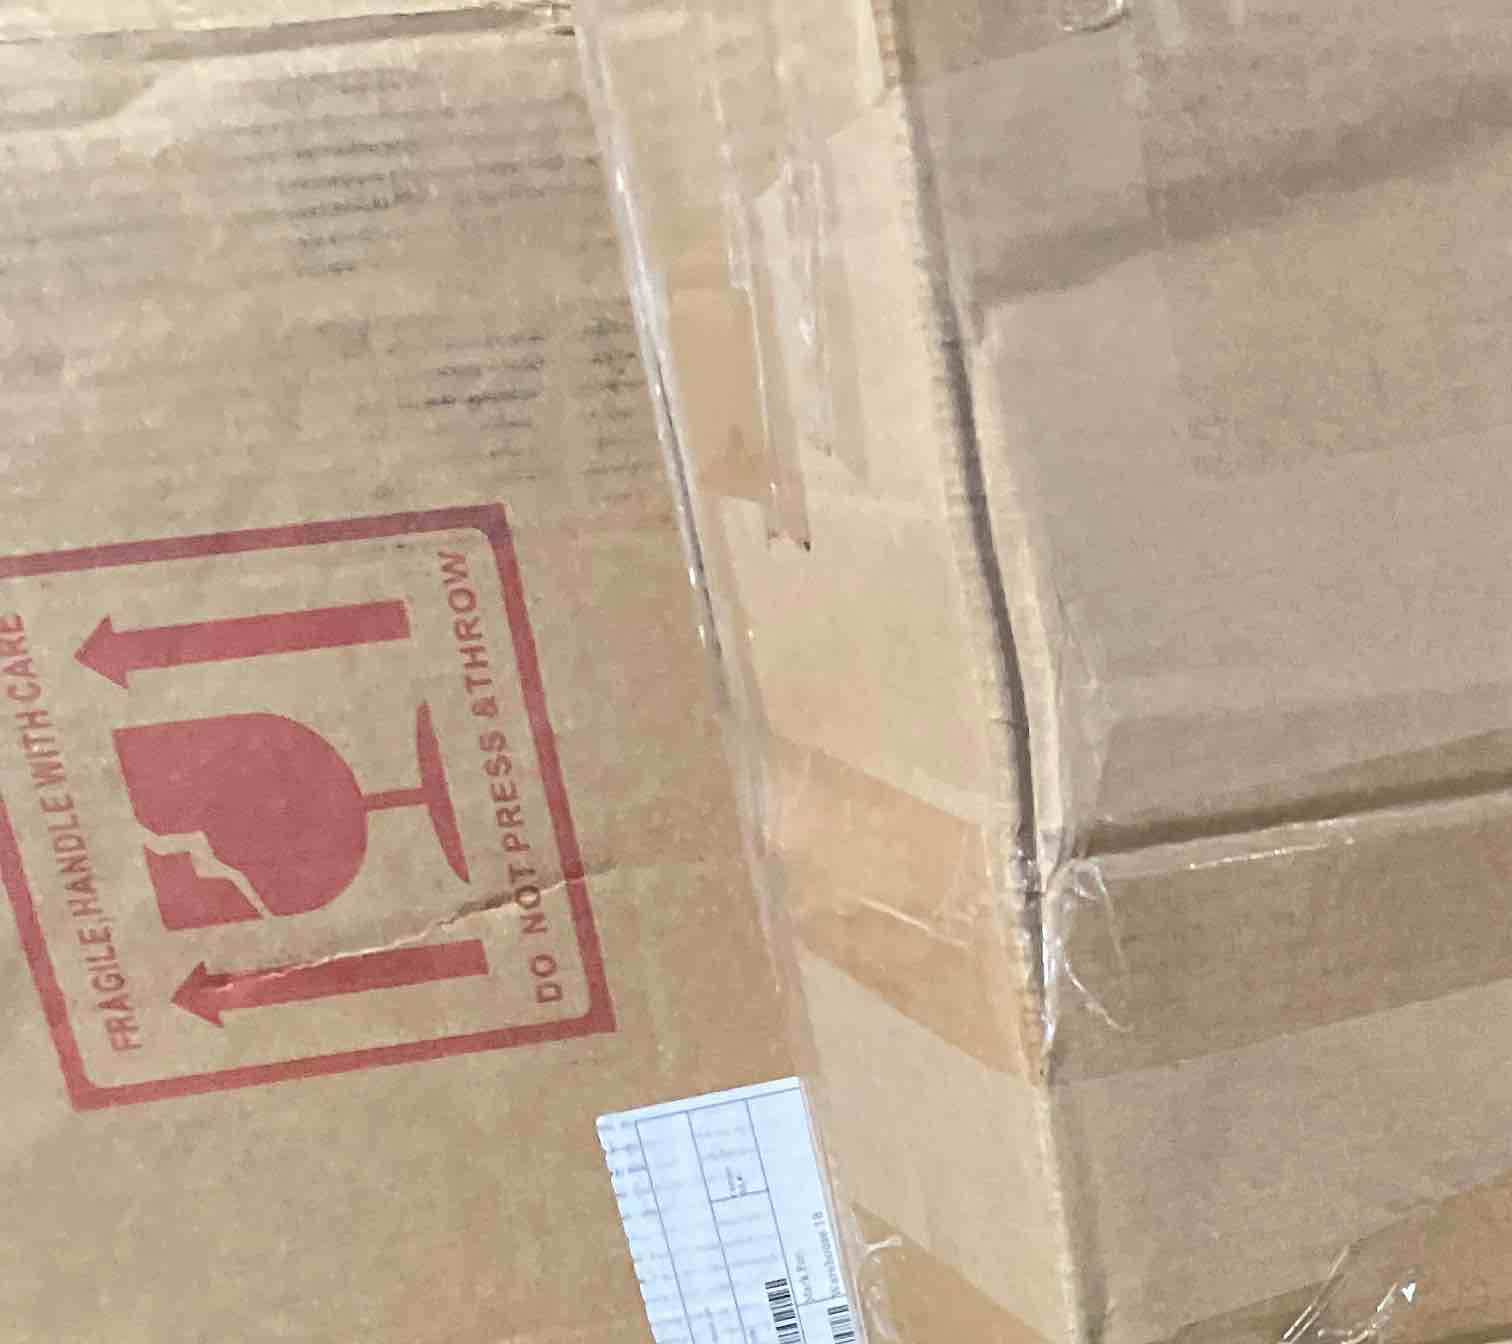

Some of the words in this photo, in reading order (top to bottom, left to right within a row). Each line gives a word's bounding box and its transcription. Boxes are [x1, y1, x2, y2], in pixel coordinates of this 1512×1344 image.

[15, 705, 65, 789] WITH
[479, 729, 531, 856] PRESS
[508, 864, 548, 935] NOT
[528, 953, 563, 1005] DO
